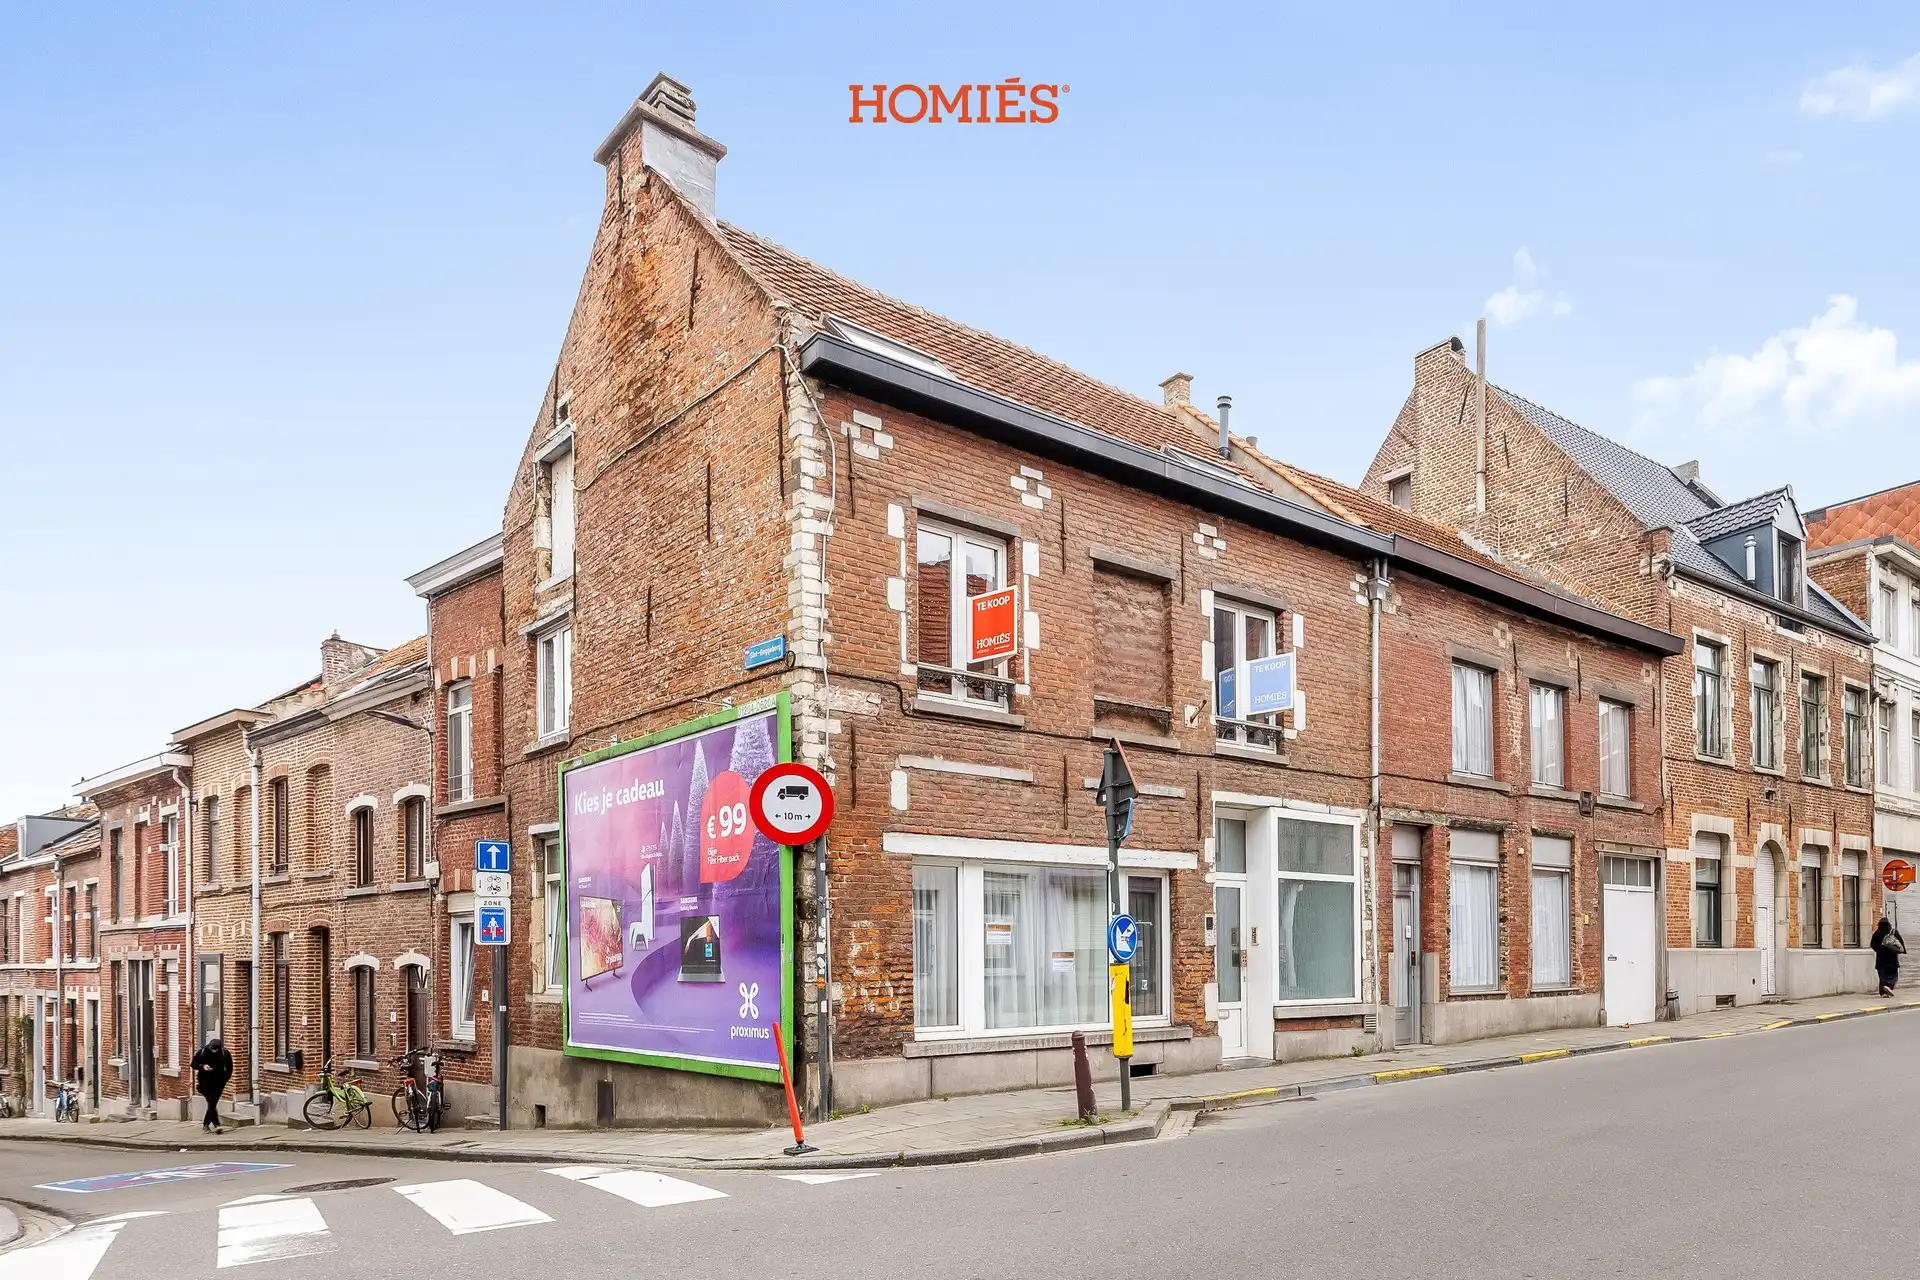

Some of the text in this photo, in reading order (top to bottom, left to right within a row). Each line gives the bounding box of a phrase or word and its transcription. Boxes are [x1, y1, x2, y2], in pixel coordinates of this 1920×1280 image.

[976, 595, 1011, 611] TE KOOP
[976, 632, 1011, 649] HOMIÉS
[1254, 660, 1287, 673] TE KOOP
[574, 778, 665, 815] Kies je cadeau
[707, 802, 747, 839] € 99
[730, 1025, 770, 1040] proximus
